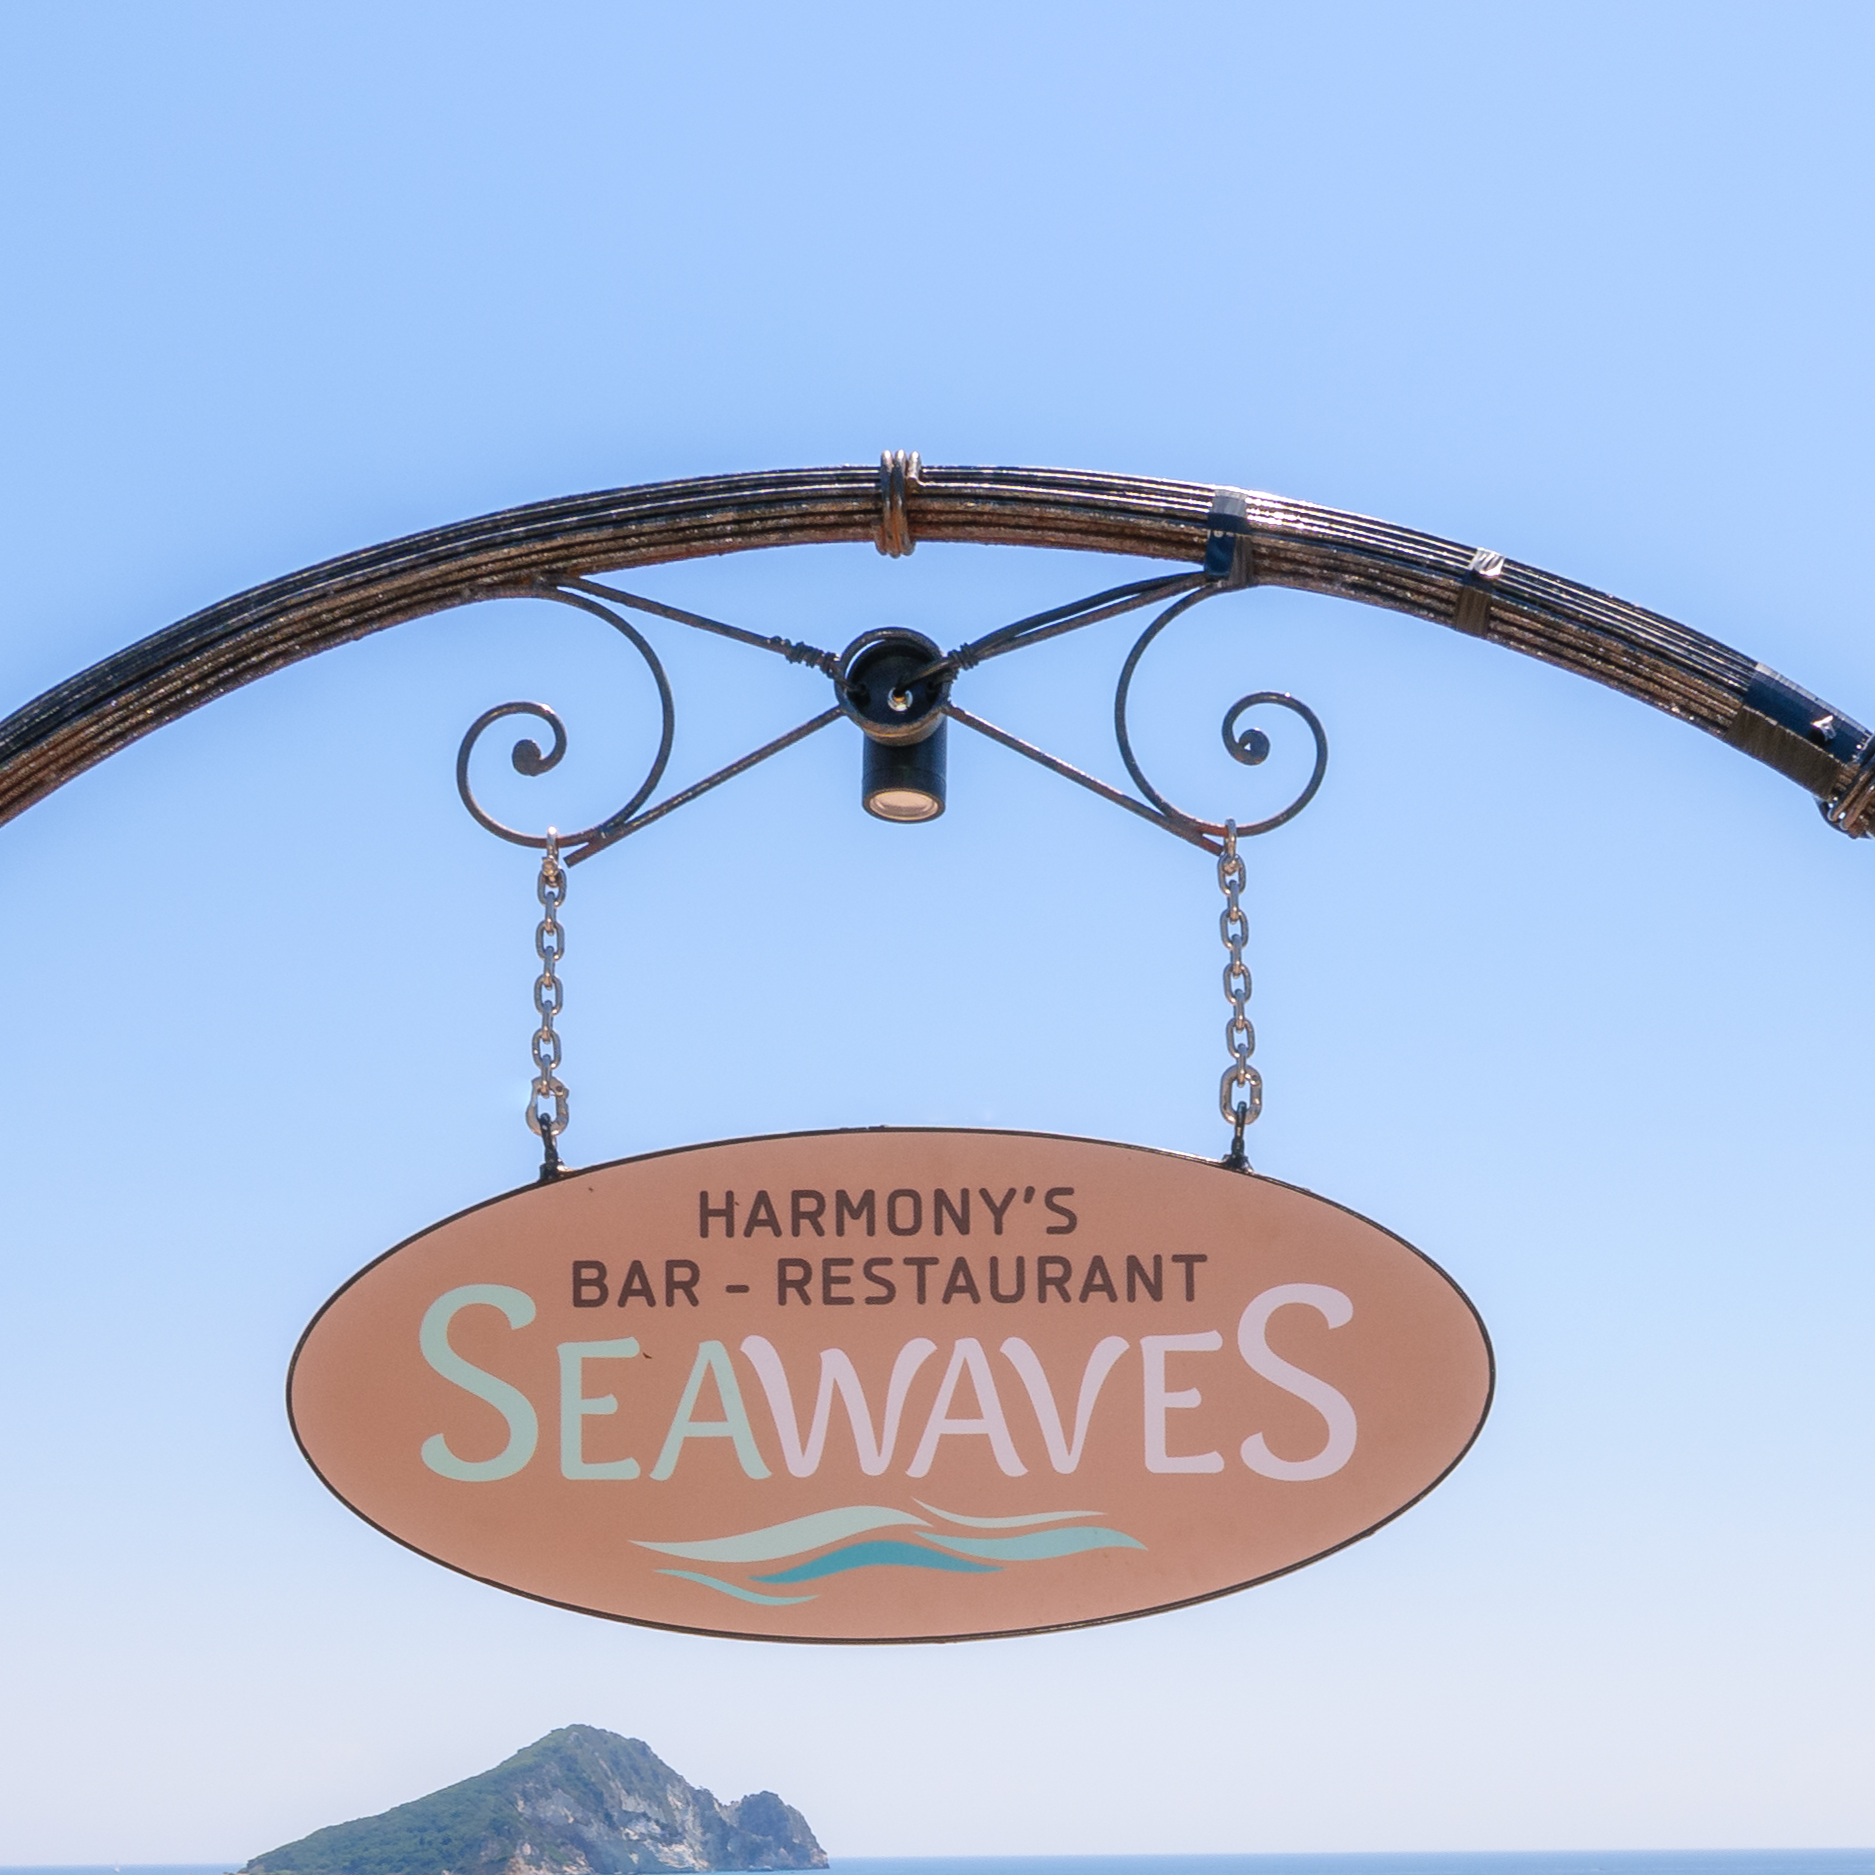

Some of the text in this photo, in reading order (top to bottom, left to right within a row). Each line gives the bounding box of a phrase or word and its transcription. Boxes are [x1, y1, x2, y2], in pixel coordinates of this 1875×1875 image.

[698, 1185, 1078, 1239] HARMONY'S
[571, 1258, 701, 1309] BAR
[776, 1253, 1209, 1307] RESTAURANT
[418, 1282, 1358, 1483] SEAWAVES
